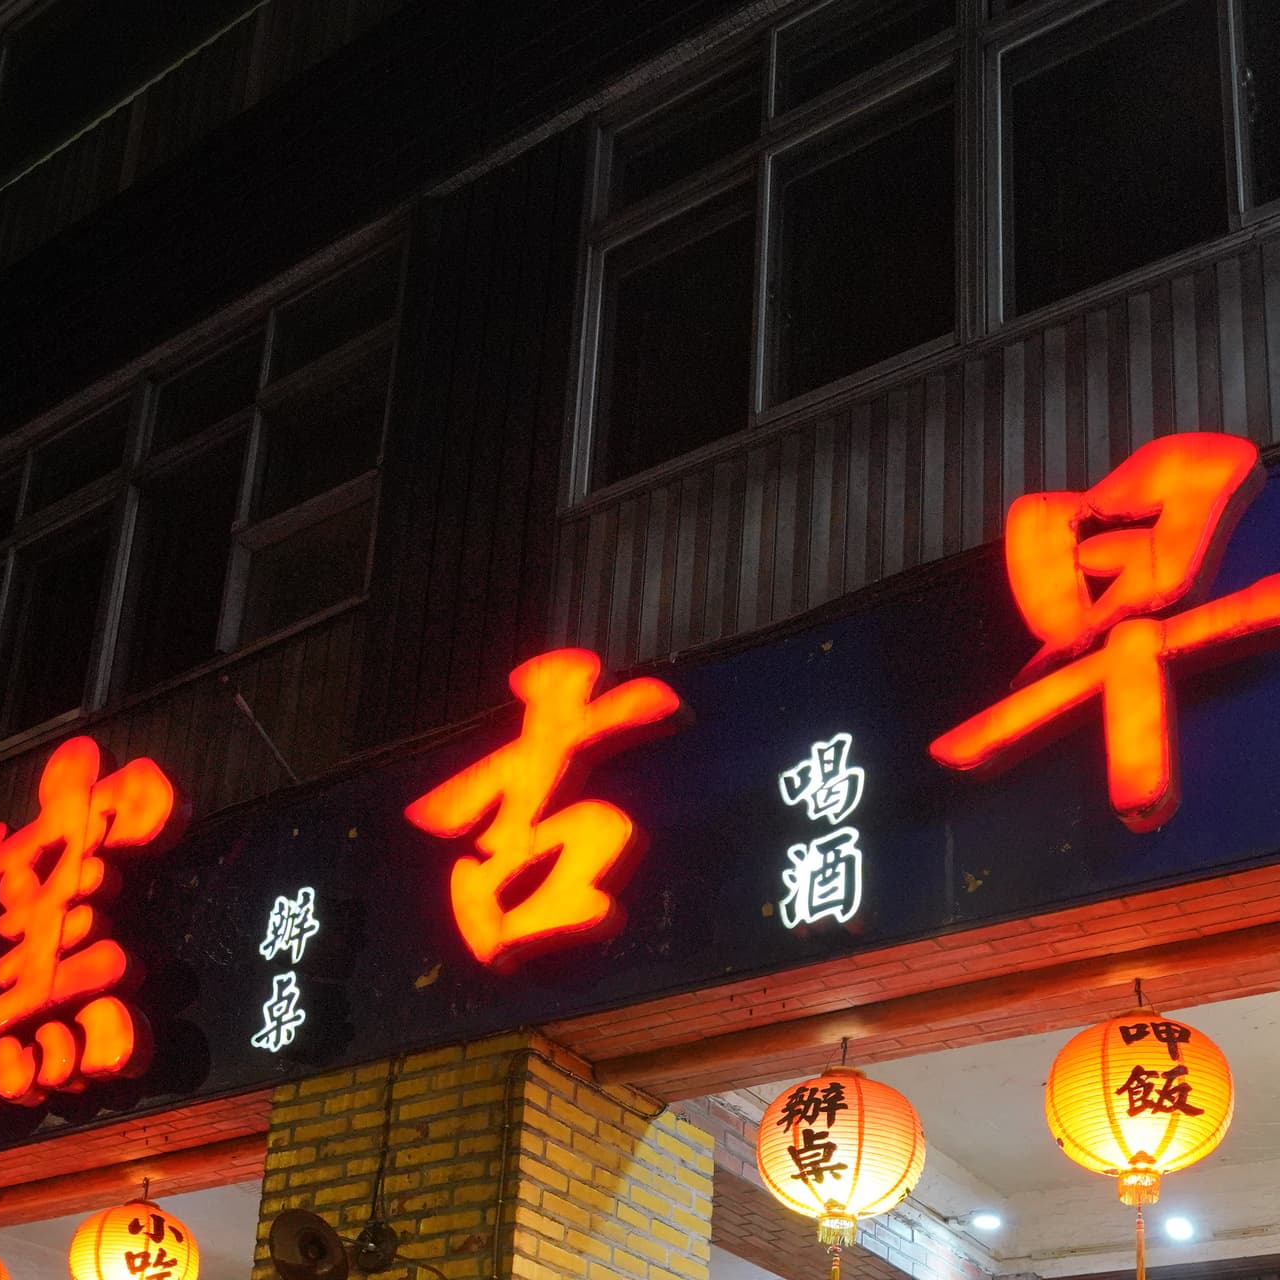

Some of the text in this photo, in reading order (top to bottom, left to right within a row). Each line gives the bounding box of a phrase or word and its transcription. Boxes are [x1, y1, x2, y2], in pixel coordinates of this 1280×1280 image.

[778, 732, 866, 929] 喝酒
[250, 886, 320, 1053] 辦桌
[778, 1081, 849, 1185] 辦桌
[1117, 1022, 1205, 1118] 呷飯
